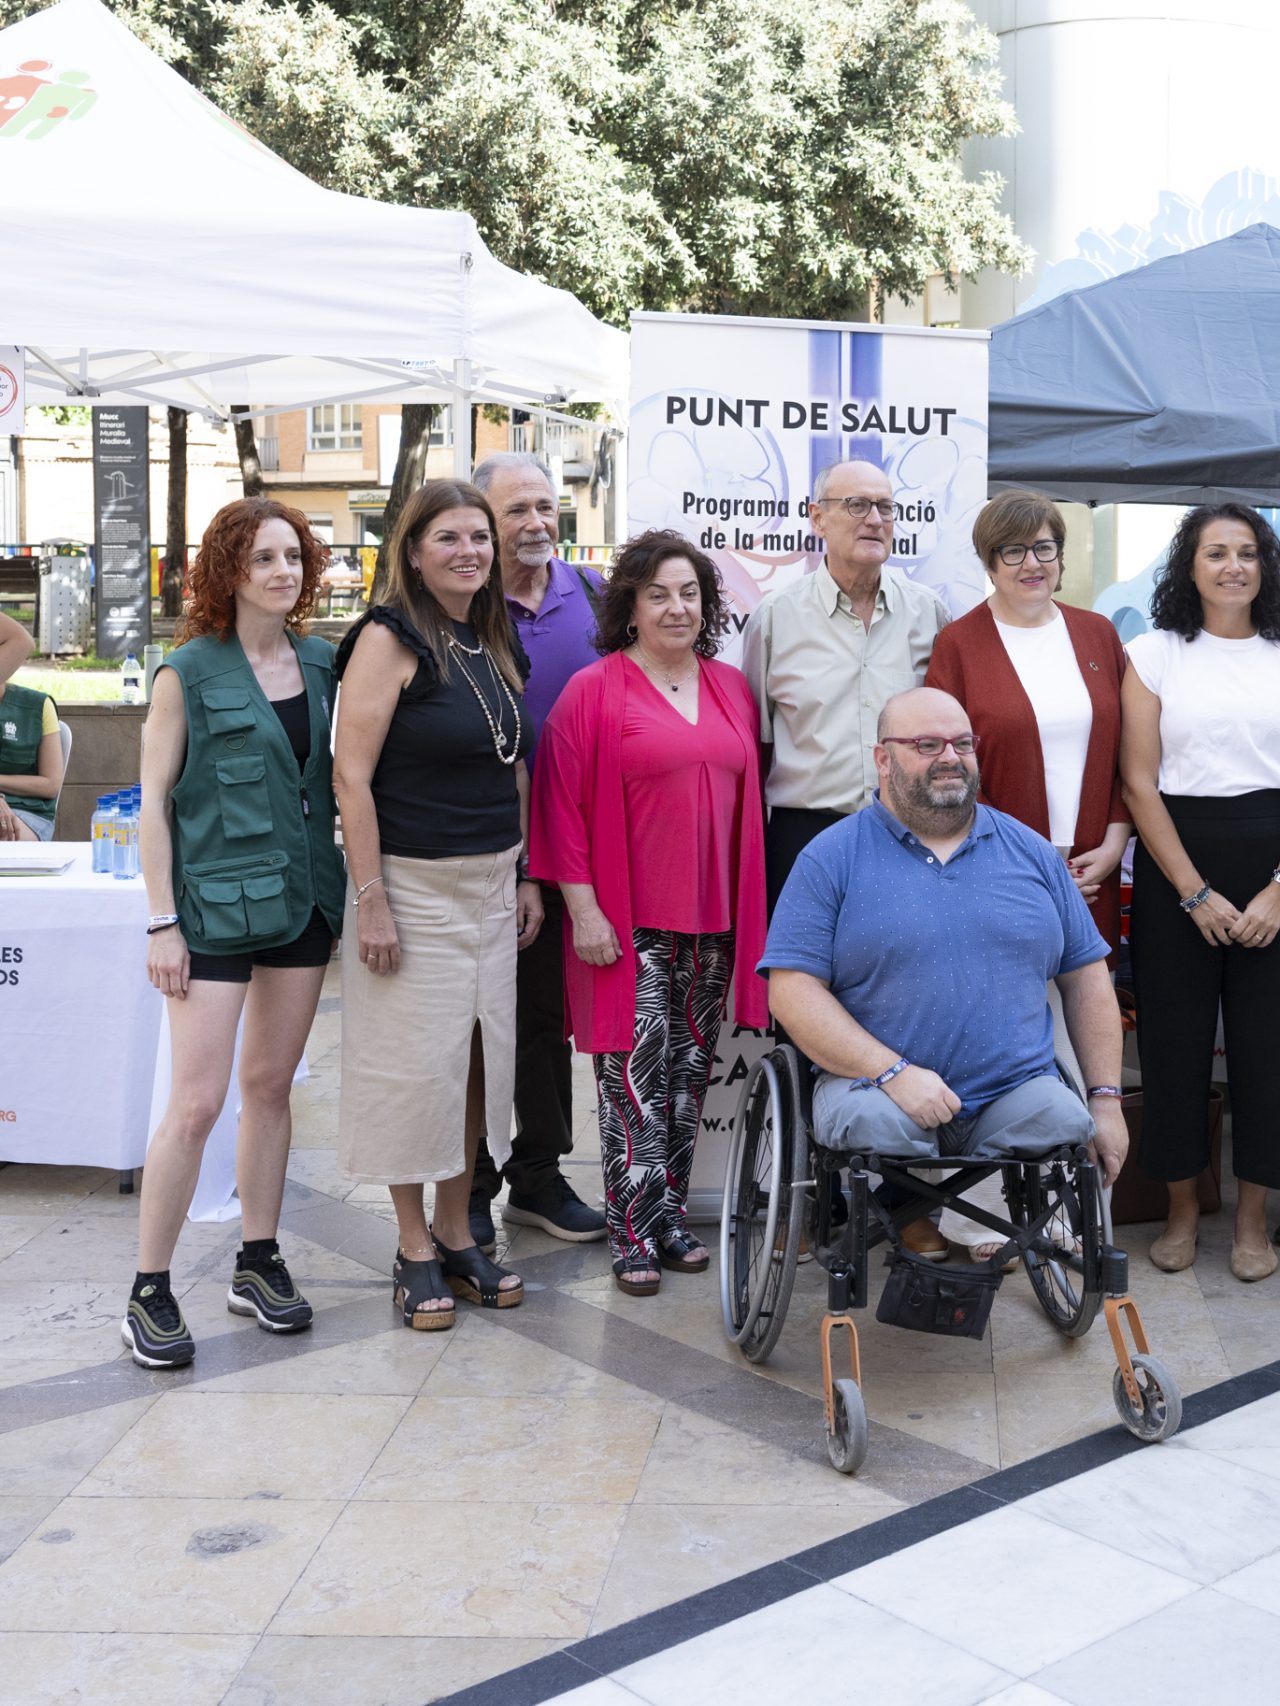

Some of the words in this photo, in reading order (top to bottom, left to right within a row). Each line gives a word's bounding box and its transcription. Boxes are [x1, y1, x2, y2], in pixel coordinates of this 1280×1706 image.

[666, 396, 770, 428] PUNT
[782, 401, 829, 431] DE
[841, 403, 957, 436] SALUT
[682, 491, 790, 521] Programa
[700, 527, 726, 549] de
[734, 528, 754, 550] la
[0, 947, 23, 963] ES
